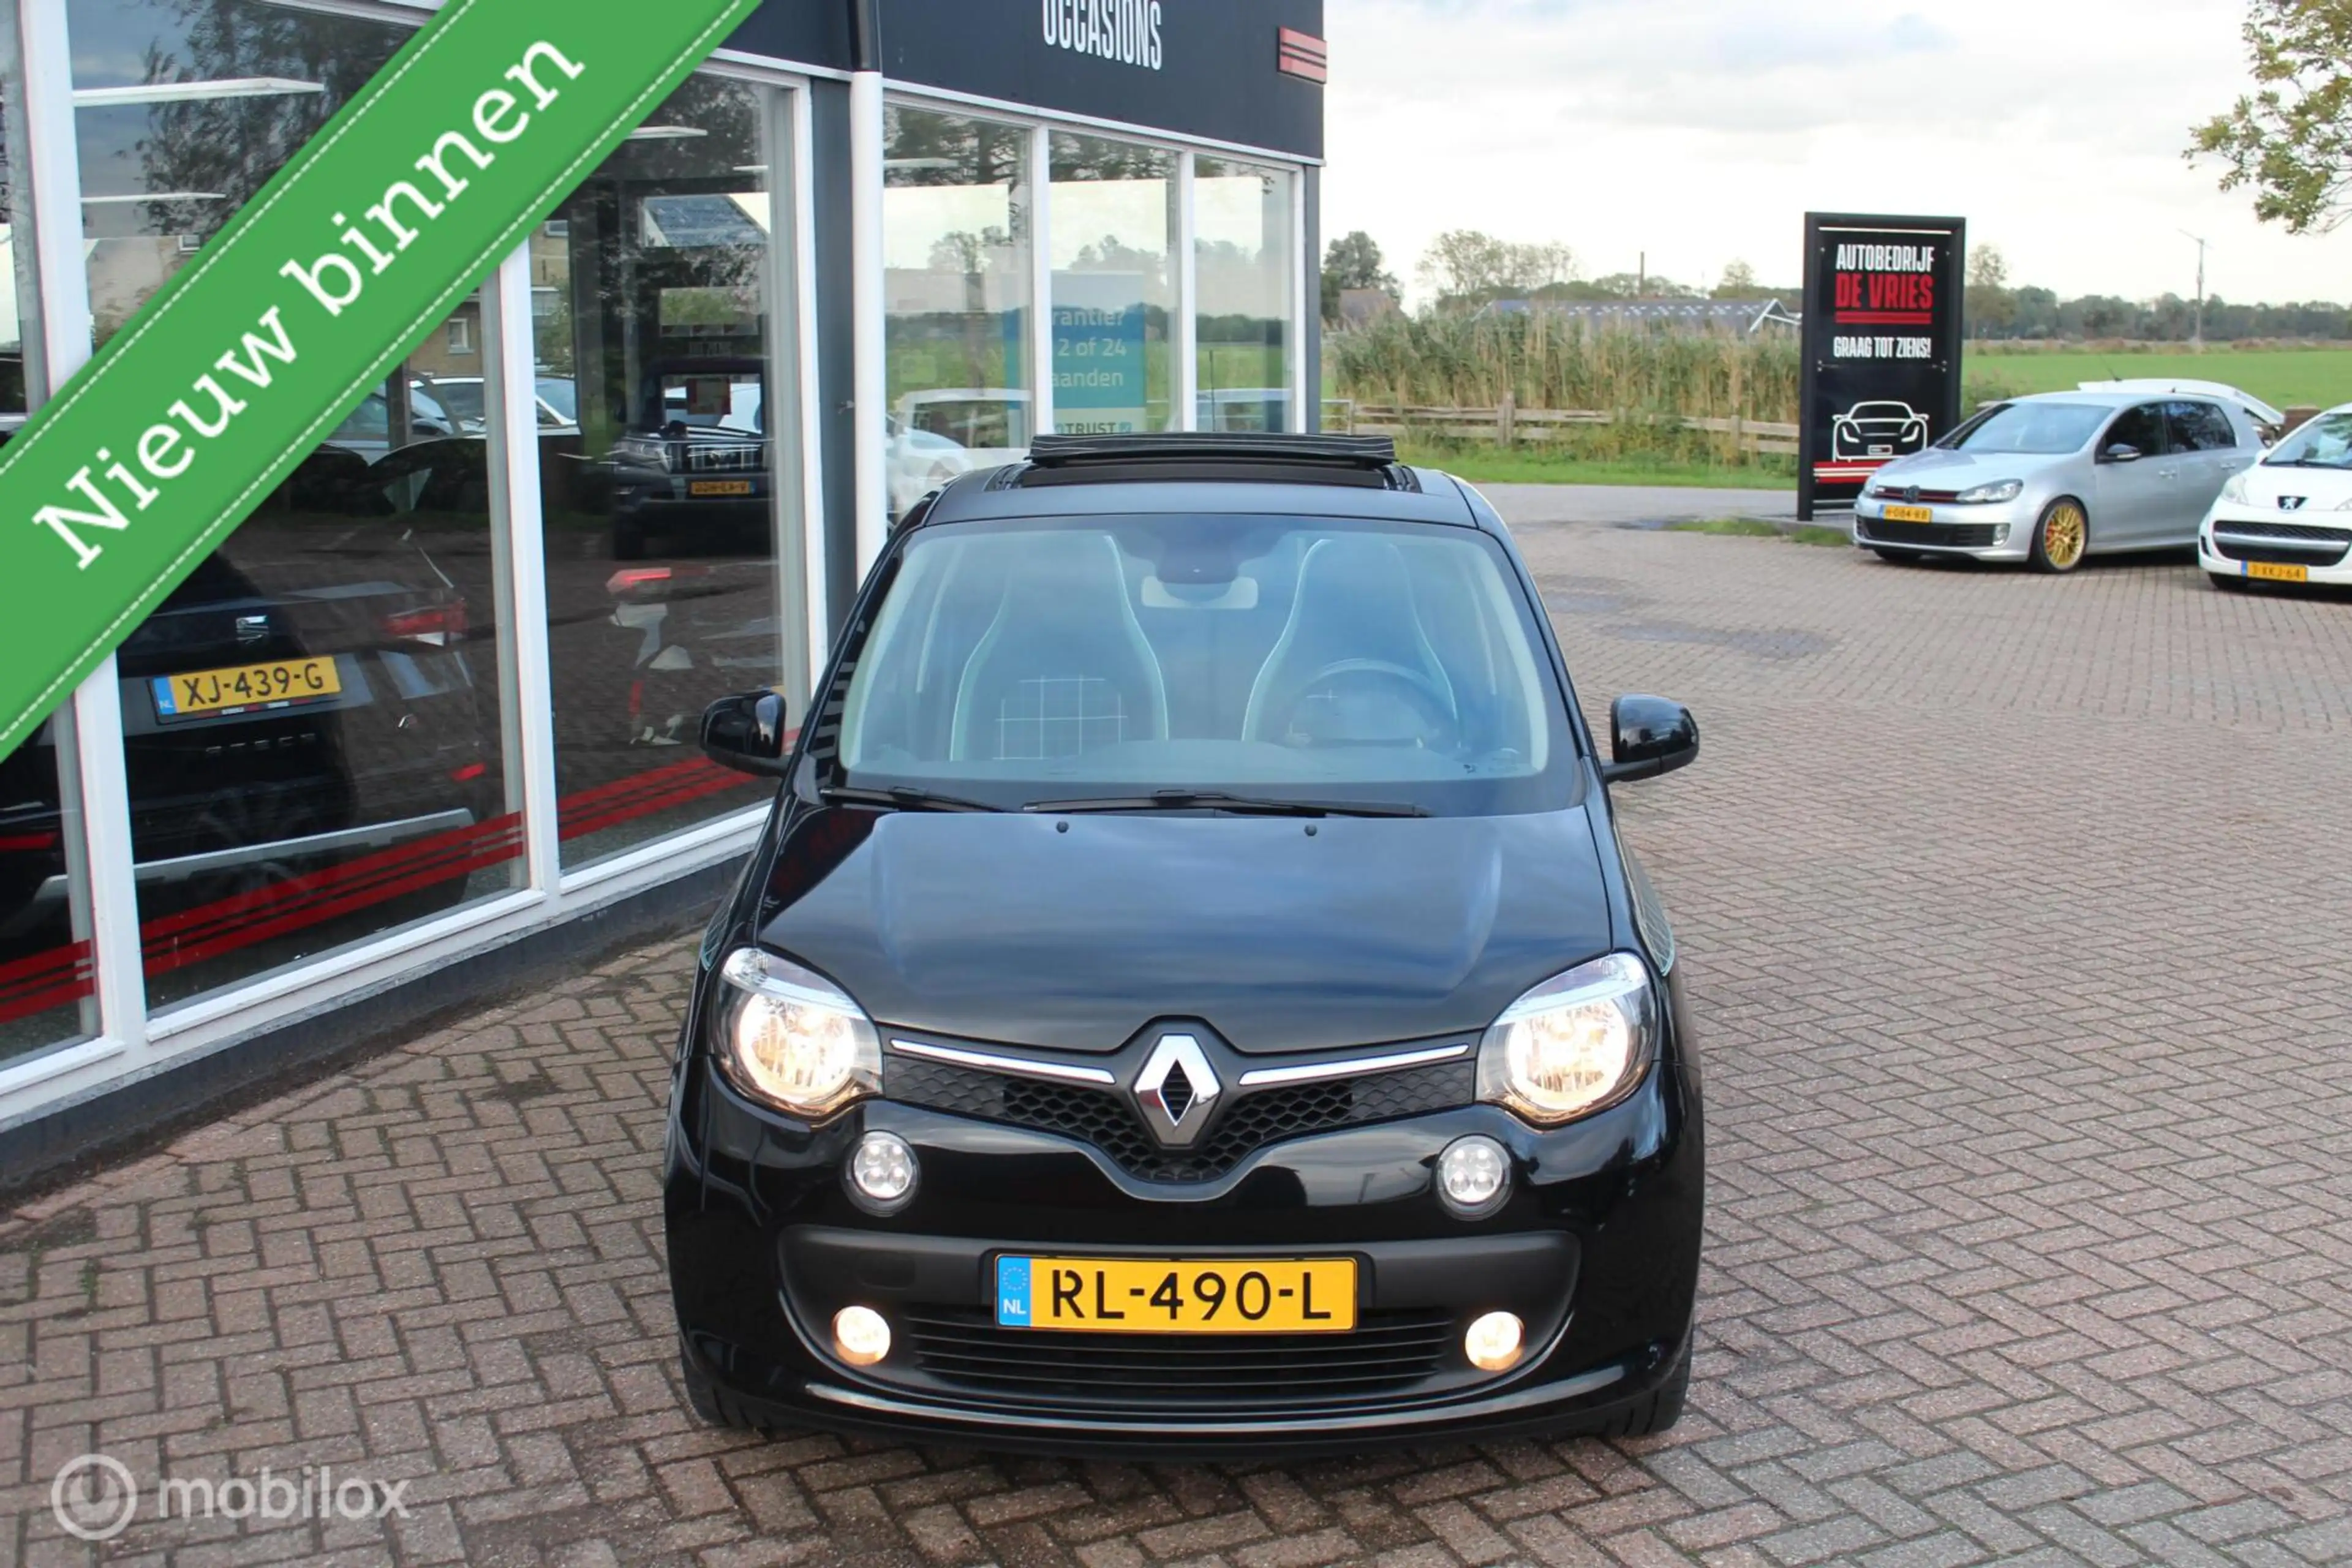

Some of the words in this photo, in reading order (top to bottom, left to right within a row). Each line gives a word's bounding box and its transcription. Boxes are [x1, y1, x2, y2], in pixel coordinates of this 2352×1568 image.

[1042, 0, 1163, 70] OCCASIONS
[1836, 244, 1934, 272] AUTOBEDRIJF
[1834, 272, 1863, 309] DE
[1868, 273, 1934, 309] VRIES
[1075, 337, 1097, 356] of
[1101, 337, 1127, 356] 24
[1833, 336, 1872, 358] GRAAG
[1874, 336, 1894, 358] TOT
[1896, 337, 1931, 358] ZIENS!
[183, 663, 323, 706] XJ-439-G
[1003, 1299, 1027, 1315] NL
[1052, 1269, 1332, 1321] RL-490-L
